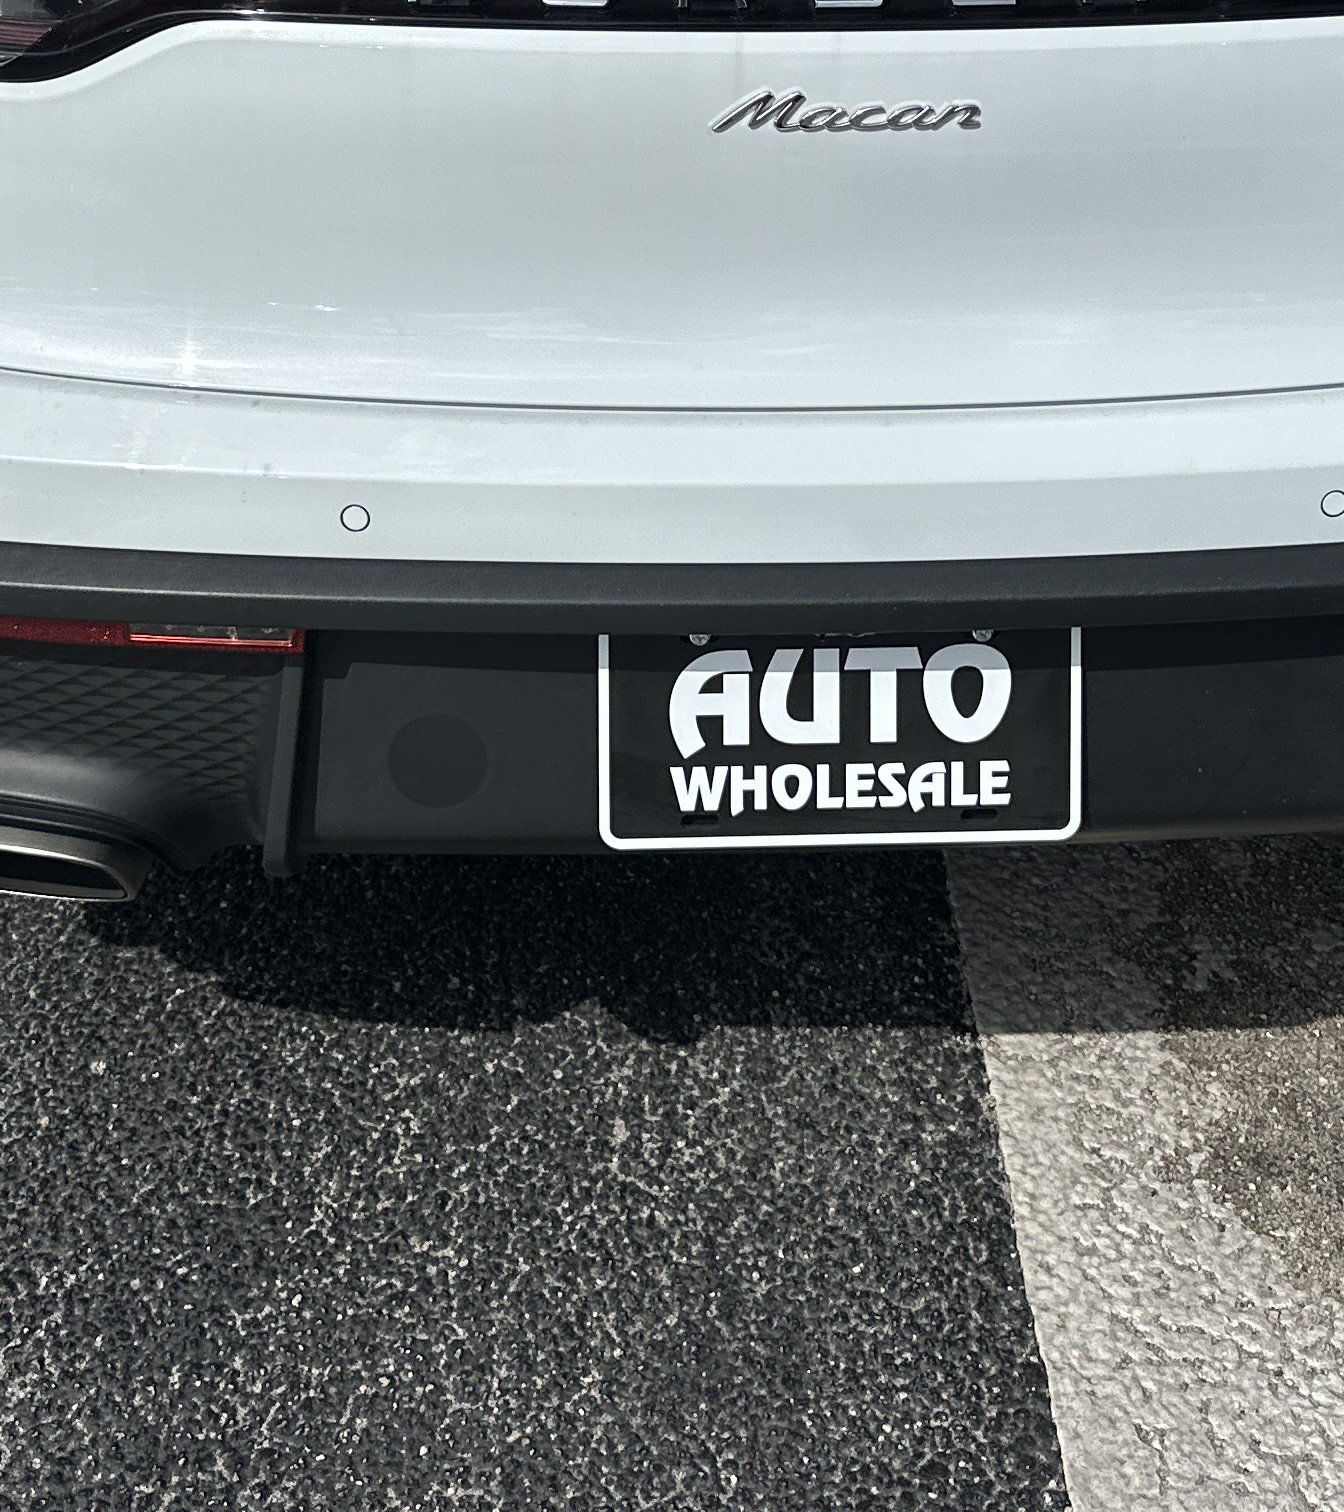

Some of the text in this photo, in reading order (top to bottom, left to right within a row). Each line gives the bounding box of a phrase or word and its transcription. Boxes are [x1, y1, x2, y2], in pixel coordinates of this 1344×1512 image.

[710, 88, 982, 135] Macan
[668, 642, 1012, 760] AUTO
[668, 759, 1012, 818] WHOLESALE
